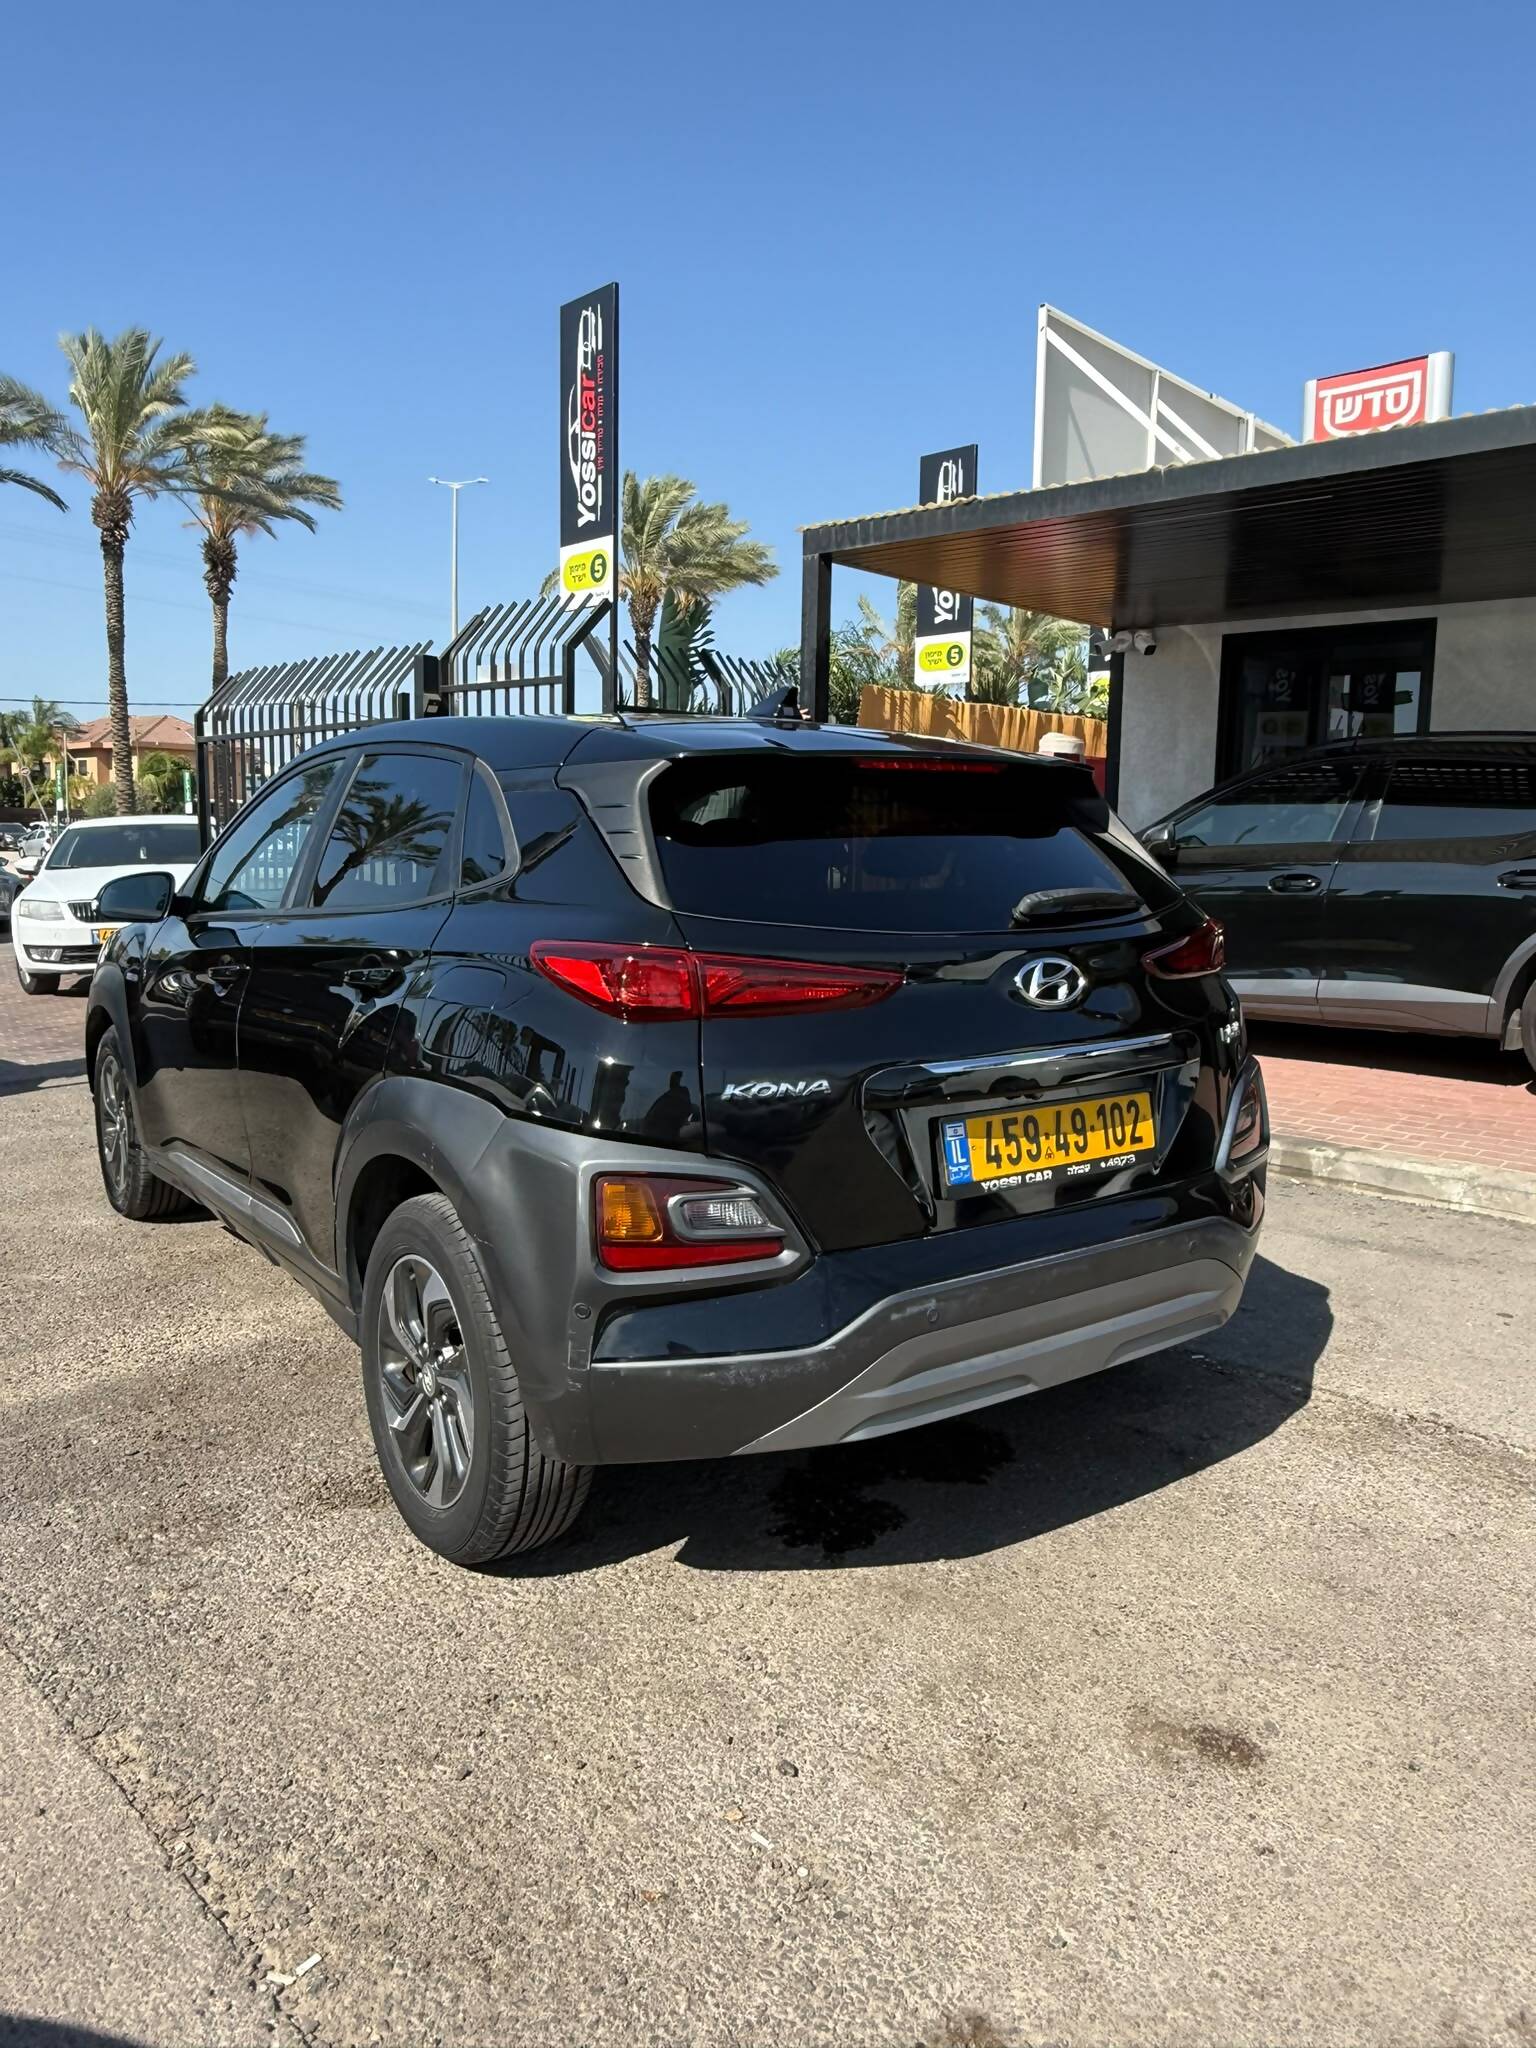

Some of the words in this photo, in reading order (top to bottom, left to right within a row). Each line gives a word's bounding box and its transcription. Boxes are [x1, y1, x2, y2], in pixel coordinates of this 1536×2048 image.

[577, 373, 597, 527] Yossicar
[721, 1079, 832, 1101] KONA
[951, 1140, 967, 1164] IL
[981, 1176, 1022, 1193] YOSSI
[1025, 1170, 1053, 1184] CAR
